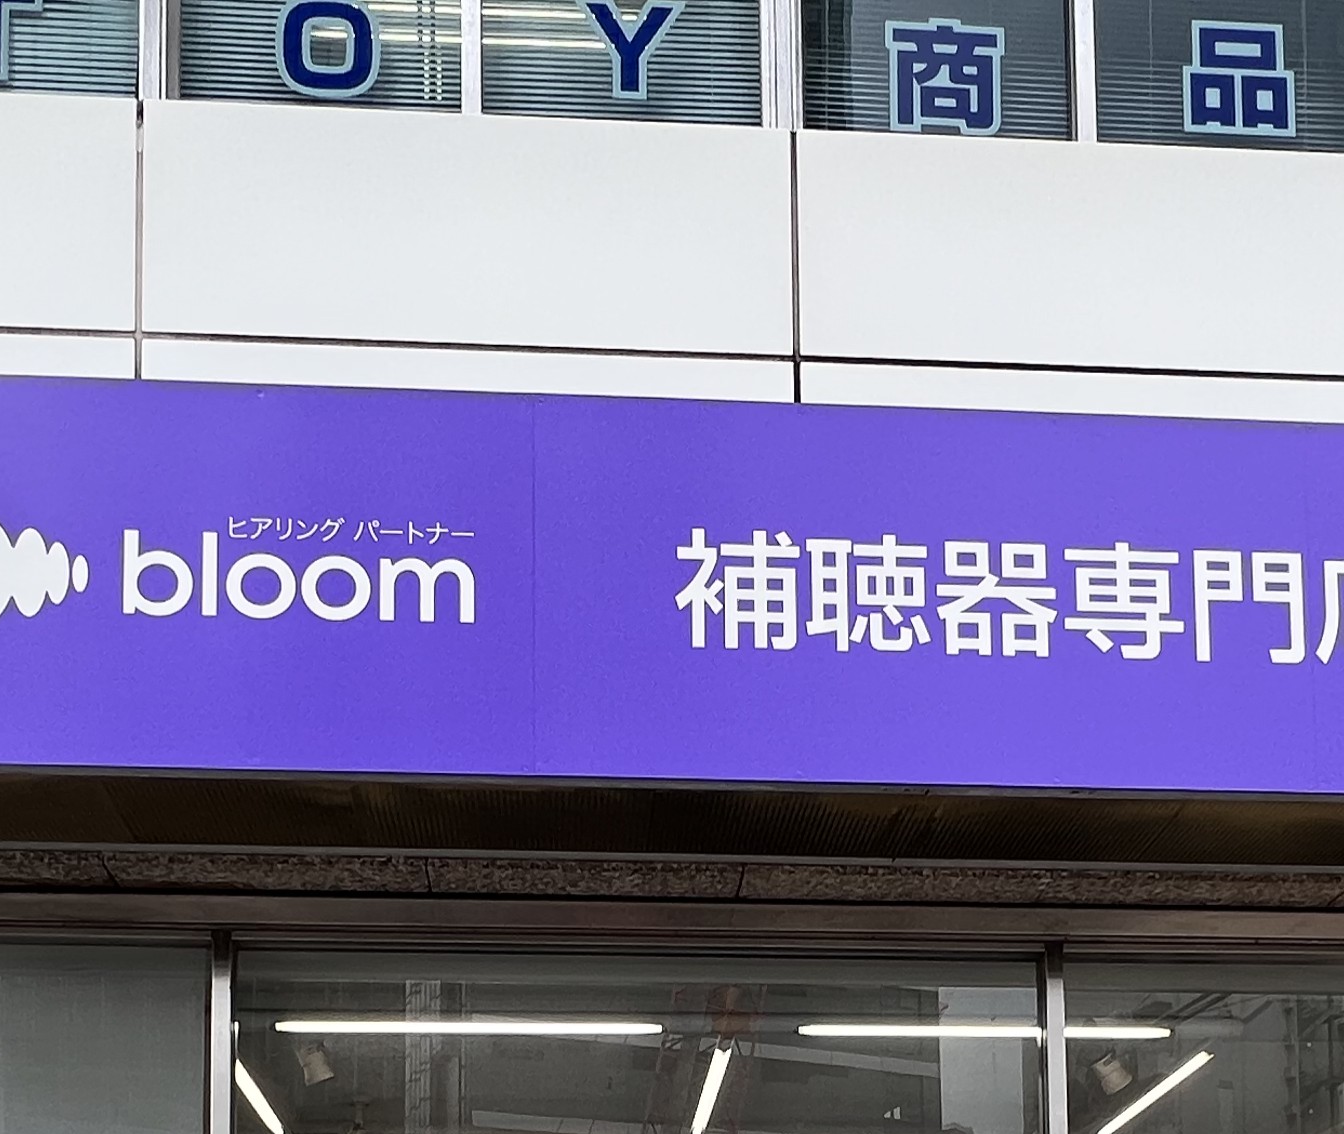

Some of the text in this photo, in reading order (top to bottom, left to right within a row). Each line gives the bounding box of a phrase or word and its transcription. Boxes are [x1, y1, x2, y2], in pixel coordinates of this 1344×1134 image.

[227, 516, 475, 545] ヒアリング パートナー
[122, 529, 475, 624] bloom
